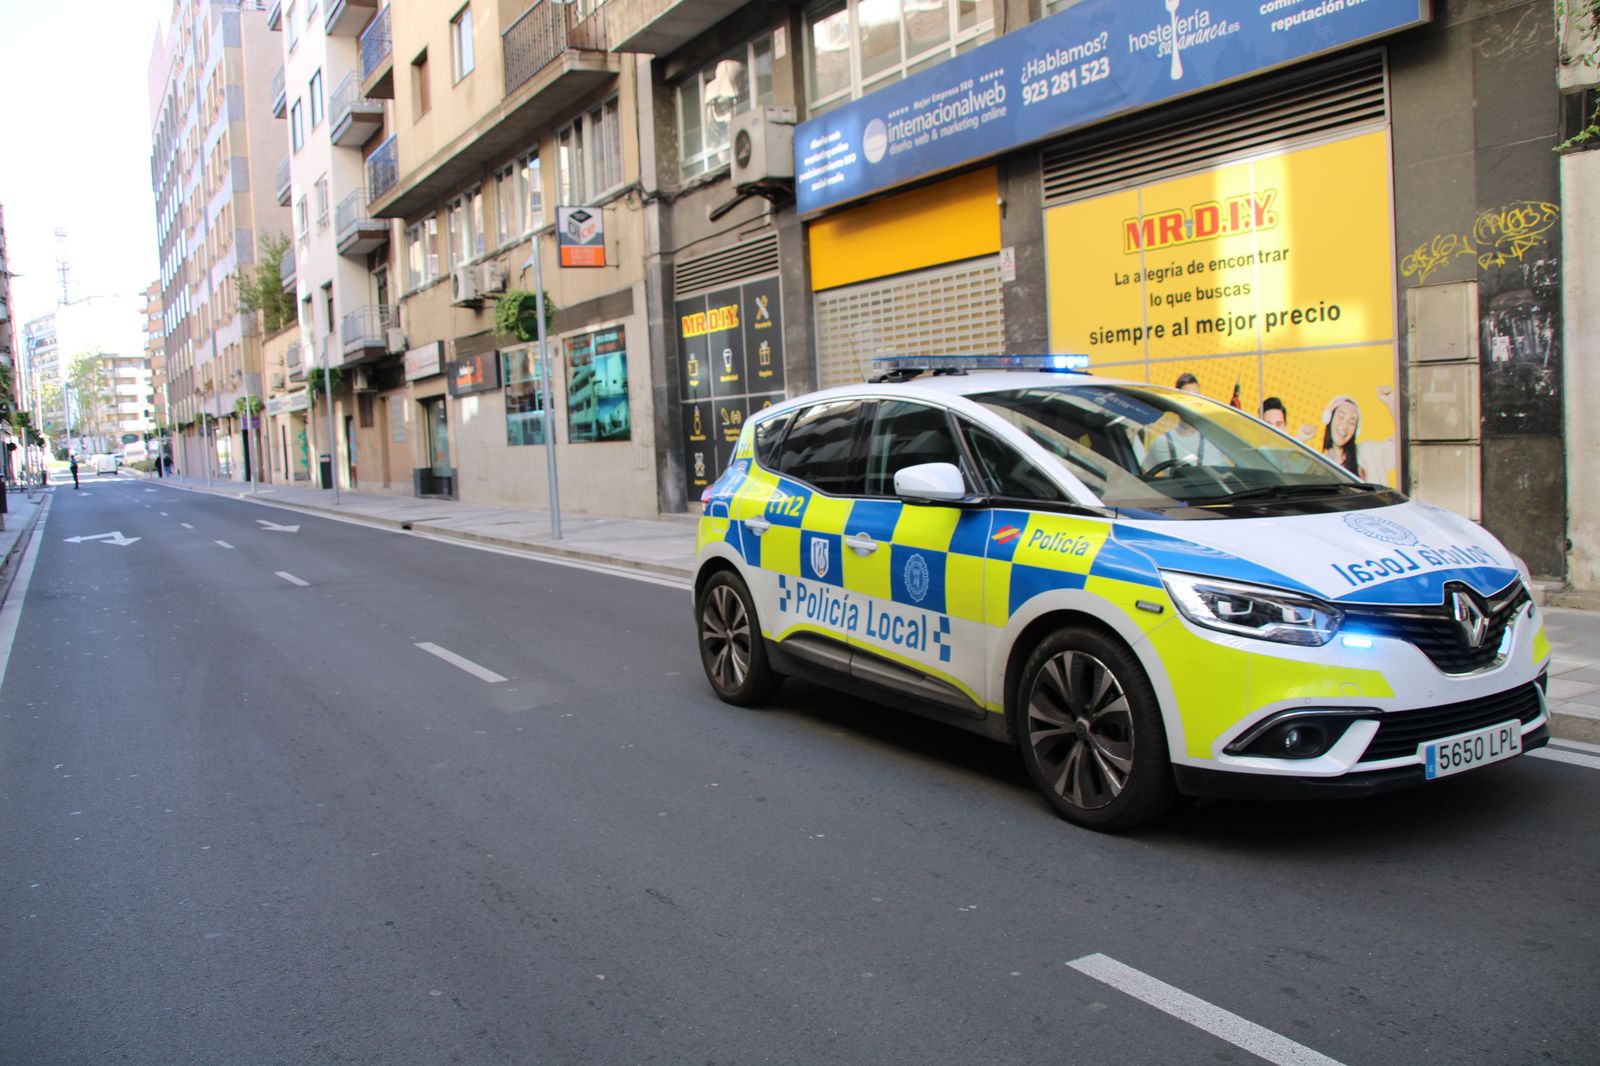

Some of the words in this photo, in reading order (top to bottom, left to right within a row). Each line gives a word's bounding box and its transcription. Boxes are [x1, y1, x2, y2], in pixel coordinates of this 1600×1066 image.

[1271, 0, 1345, 32] reputación
[1020, 31, 1108, 84] ¿Hablamos?
[1022, 79, 1049, 106] 923
[1051, 68, 1077, 96] 281
[1081, 56, 1110, 85] 523
[888, 80, 1006, 142] internacionalweb
[914, 132, 930, 146] web
[931, 128, 938, 140] &
[940, 116, 979, 137] marketing
[981, 106, 1007, 123] online
[1115, 272, 1130, 286] La
[1133, 261, 1183, 284] alegría
[1187, 260, 1204, 275] de
[1208, 248, 1289, 271] encontrar
[1150, 292, 1162, 306] lo
[1166, 286, 1192, 307] que
[1196, 283, 1251, 301] buscas
[1089, 323, 1165, 345] siempre
[1171, 317, 1189, 337] al
[1196, 311, 1256, 336] mejor
[1265, 301, 1341, 332] precio
[775, 495, 805, 517] 112
[1028, 529, 1090, 557] Policía
[796, 582, 859, 632] Policía
[866, 600, 927, 652] Local
[1440, 736, 1483, 770] 5650
[1490, 727, 1518, 757] LPL
